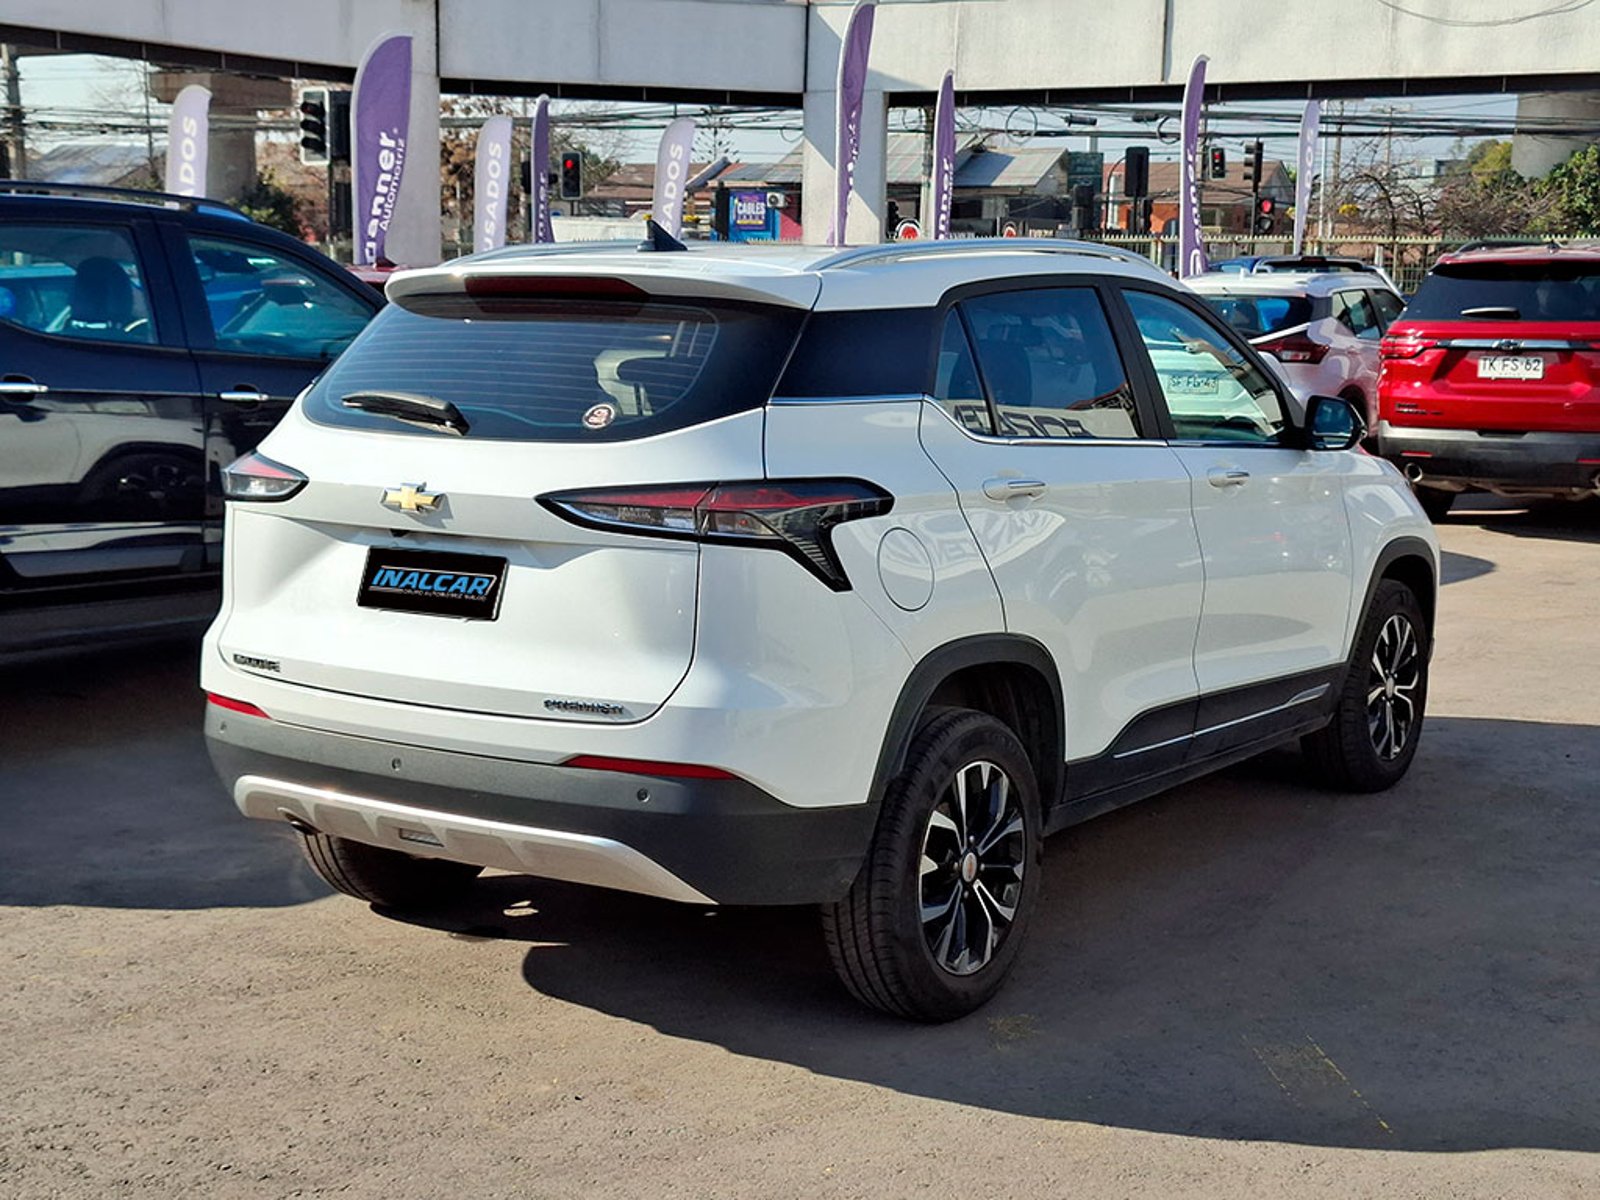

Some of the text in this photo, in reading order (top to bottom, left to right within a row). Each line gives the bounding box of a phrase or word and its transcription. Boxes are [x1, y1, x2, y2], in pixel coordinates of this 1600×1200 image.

[379, 138, 406, 232] Automotriz
[484, 142, 502, 250] USADOS
[1482, 357, 1498, 371] TK
[371, 568, 490, 596] INALCAR
